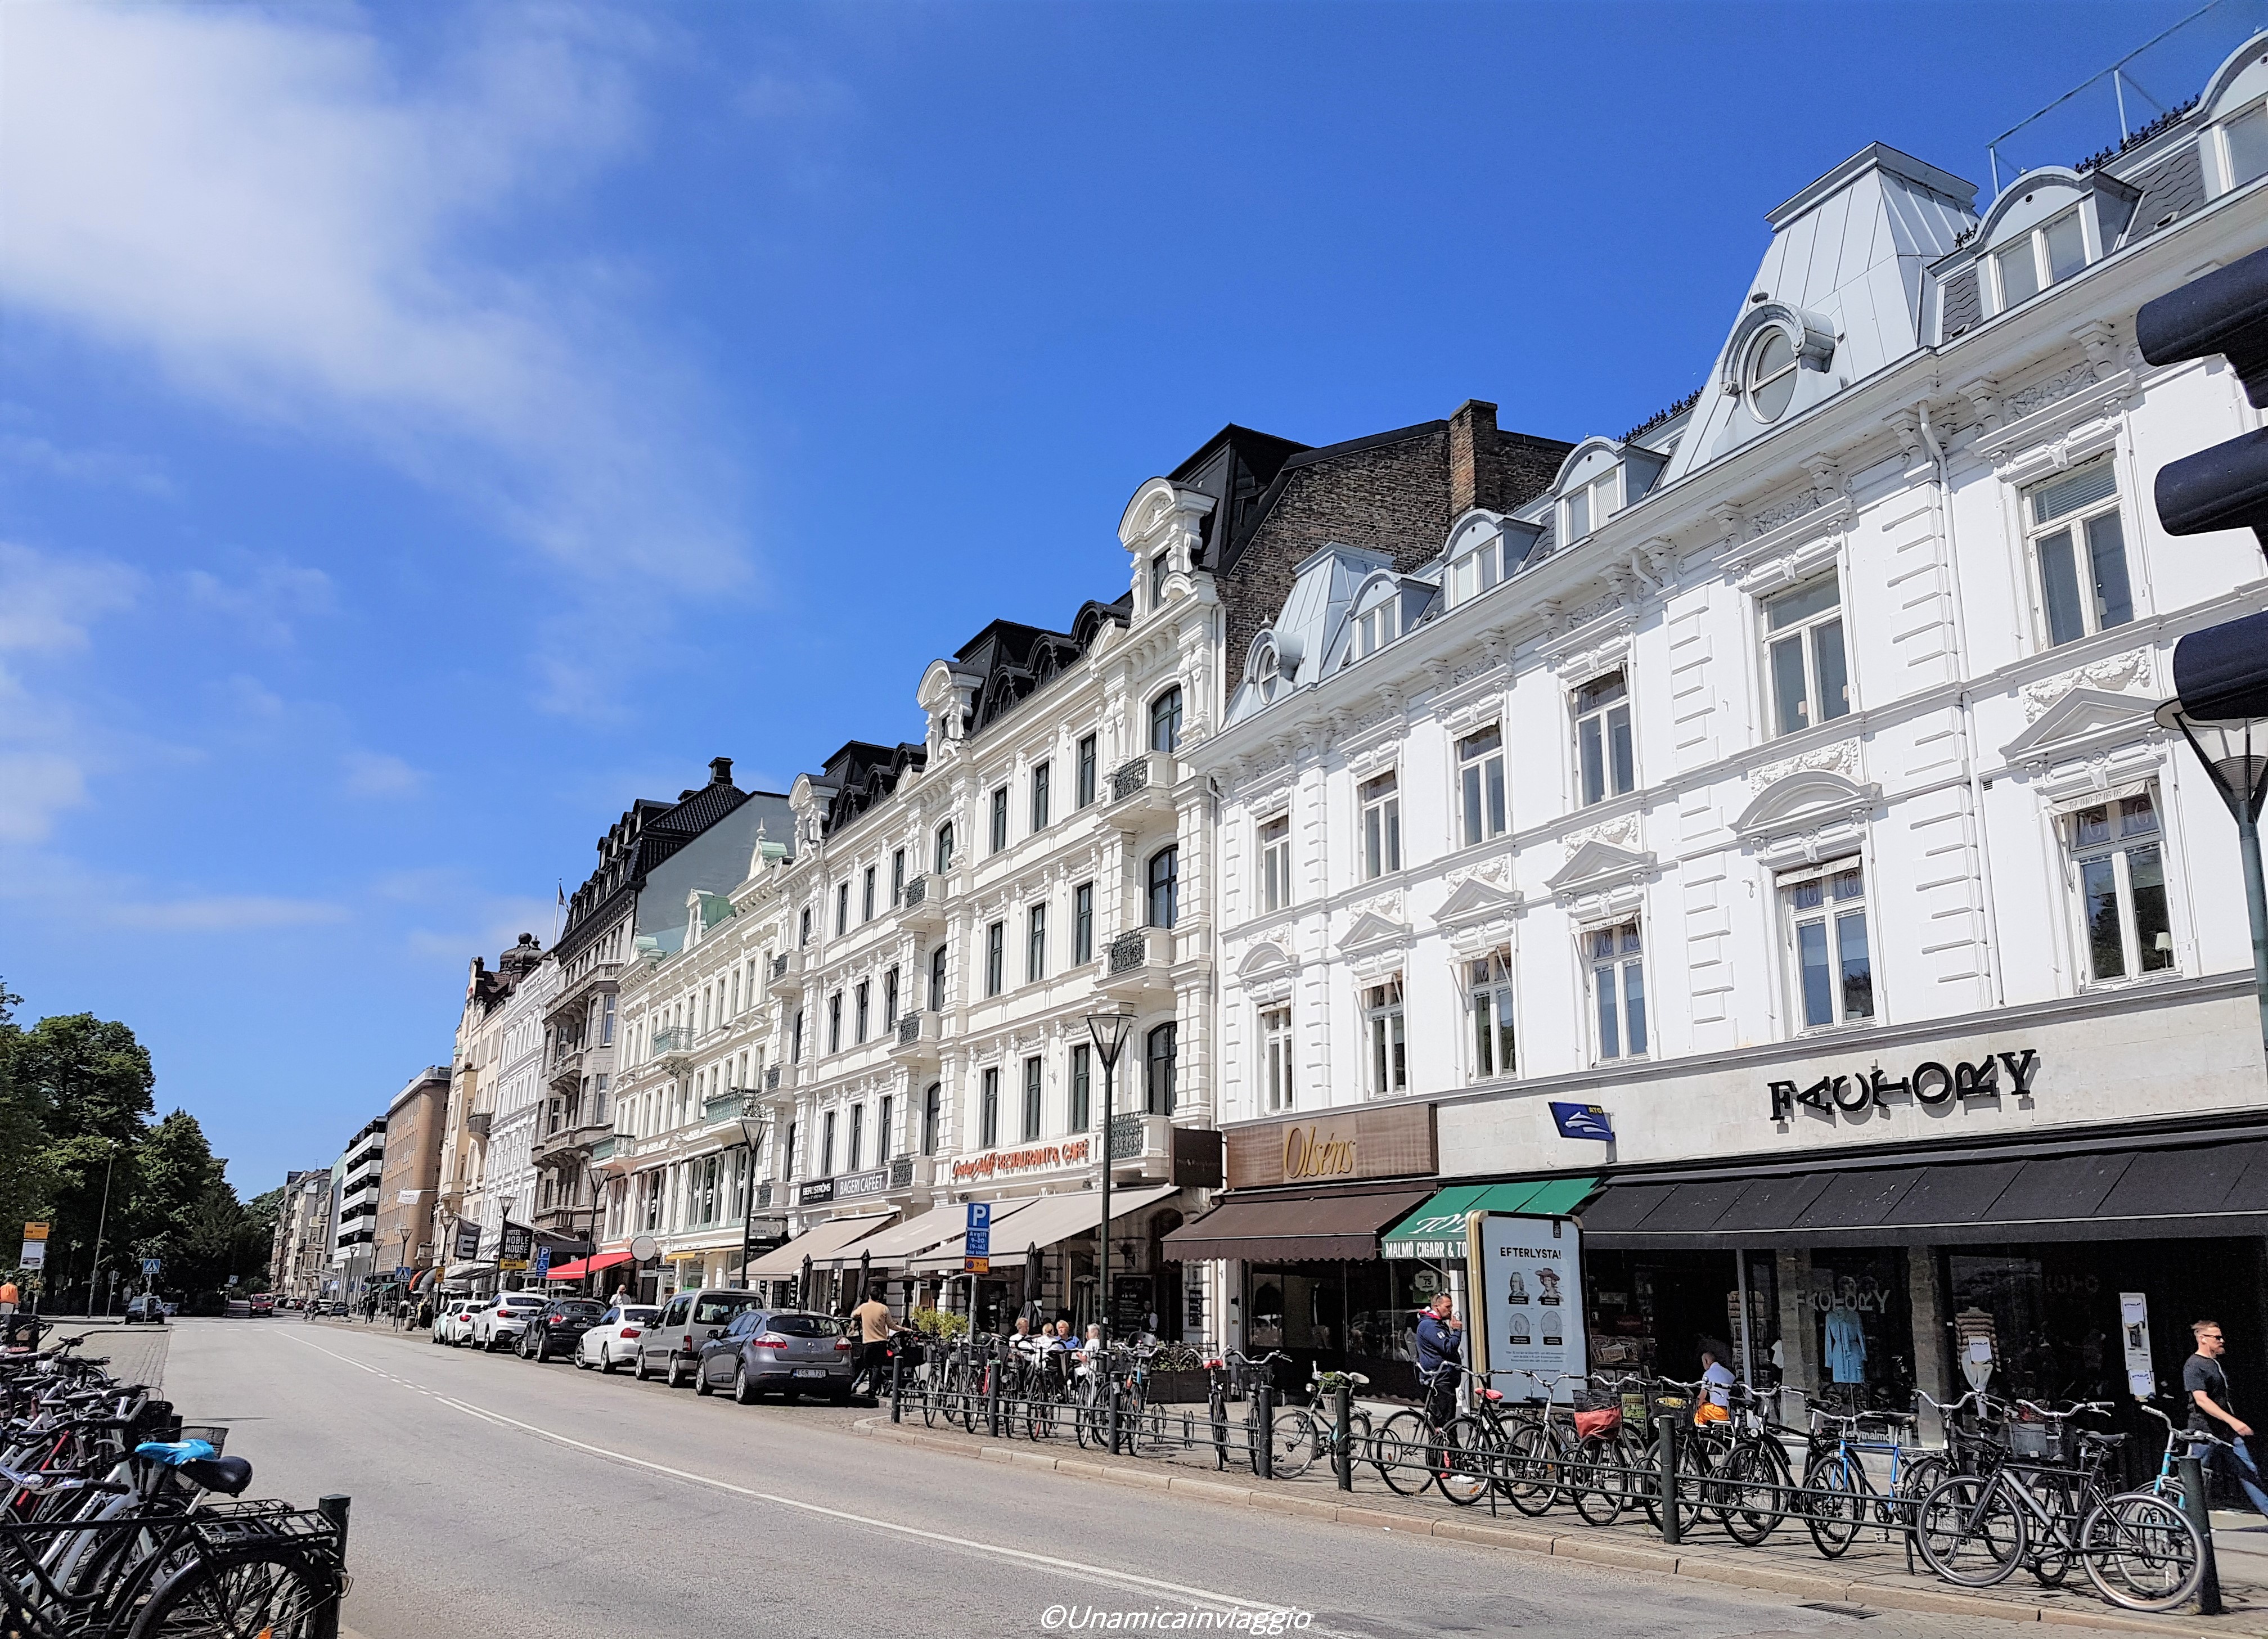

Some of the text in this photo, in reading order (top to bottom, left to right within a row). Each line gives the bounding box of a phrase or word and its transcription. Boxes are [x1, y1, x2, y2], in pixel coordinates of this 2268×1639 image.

[1767, 1049, 2037, 1121] FACTORY
[997, 1146, 1052, 1169] RESTAURANT
[1052, 1146, 1060, 1162] &
[1062, 1138, 1088, 1161] CAFÉ
[1283, 1125, 1356, 1178] Olséns
[840, 1173, 883, 1195] BAGERI CAFÉET
[973, 1205, 987, 1226] P
[505, 1244, 528, 1254] HOUSE
[506, 1236, 530, 1245] NOBLE
[1385, 1240, 1414, 1258] MALMÖ
[1416, 1241, 1445, 1258] CIGARR
[1447, 1241, 1454, 1258] &
[541, 1248, 548, 1258] P
[1500, 1247, 1562, 1259] EFTERLYSTA!
